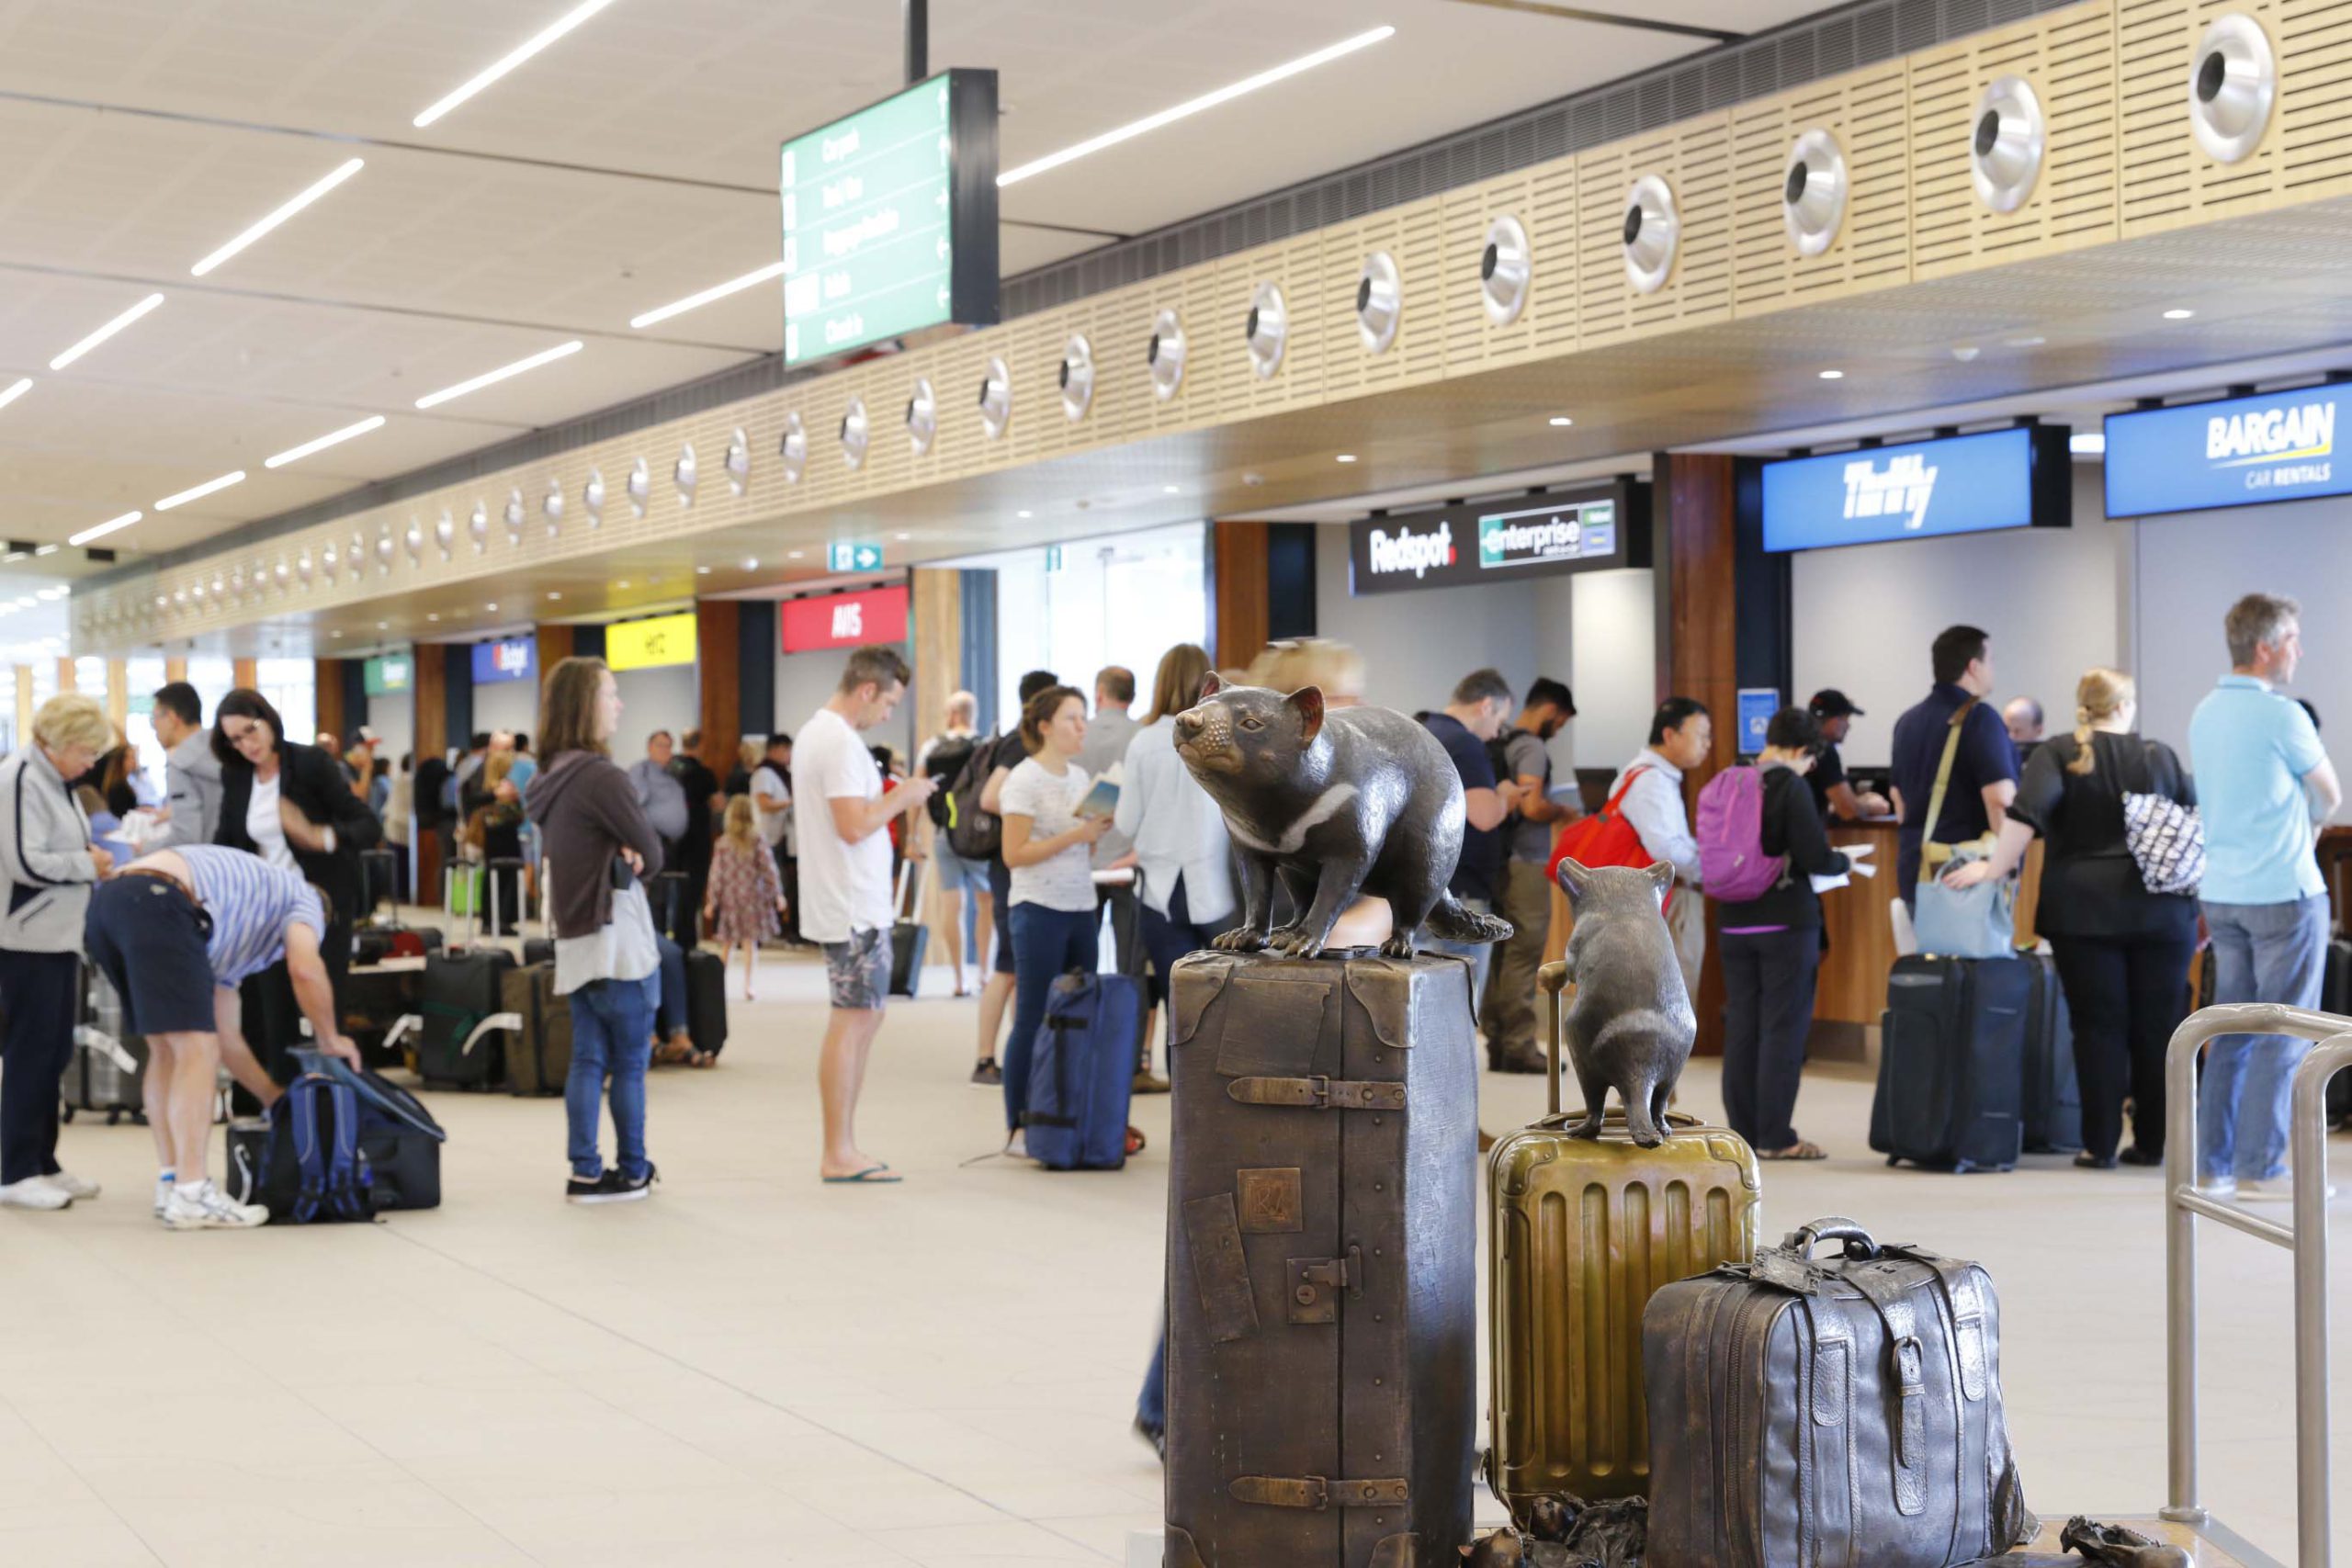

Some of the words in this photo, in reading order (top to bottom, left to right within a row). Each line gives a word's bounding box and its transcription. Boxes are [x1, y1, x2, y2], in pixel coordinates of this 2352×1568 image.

[2207, 403, 2335, 458] BARGAIN
[2245, 468, 2272, 490] CAR
[2274, 462, 2332, 486] RENTALS
